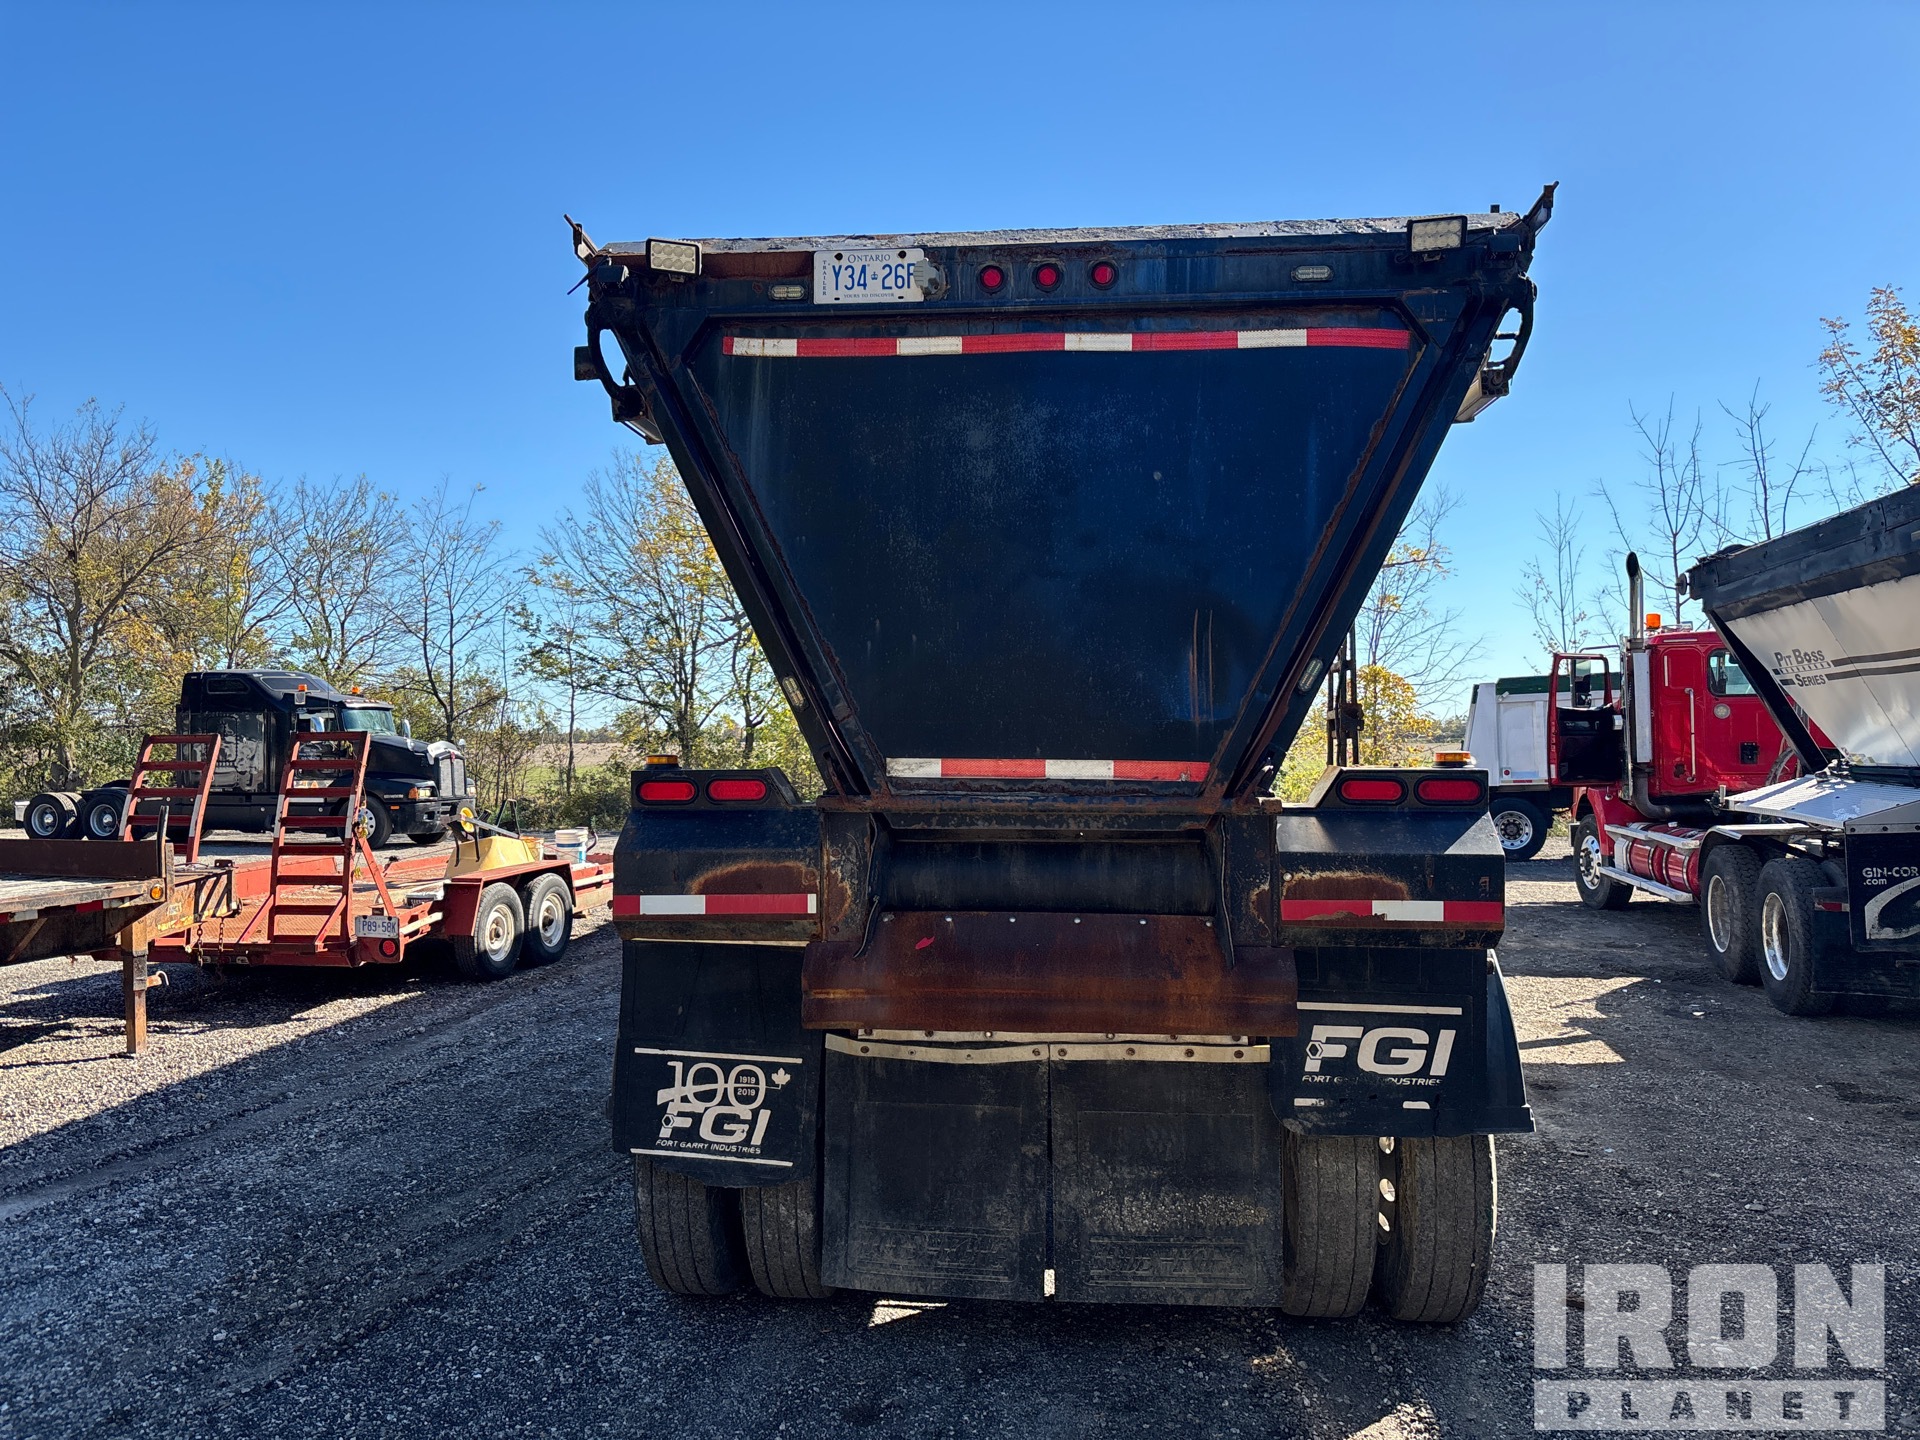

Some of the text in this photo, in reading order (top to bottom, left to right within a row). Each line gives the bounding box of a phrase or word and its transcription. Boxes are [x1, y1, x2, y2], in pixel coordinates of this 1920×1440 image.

[848, 254, 891, 264] ONTARIO
[832, 264, 868, 291] Y34
[1862, 866, 1919, 878] GIN-COR
[1863, 878, 1887, 886] .com
[1304, 1024, 1457, 1077] FGI
[666, 1060, 767, 1110] 100
[1302, 1074, 1332, 1083] FORT
[737, 1087, 756, 1097] 2019
[659, 1101, 772, 1146] FGI
[655, 1138, 762, 1154] FORT GARRY INDUSTRIES
